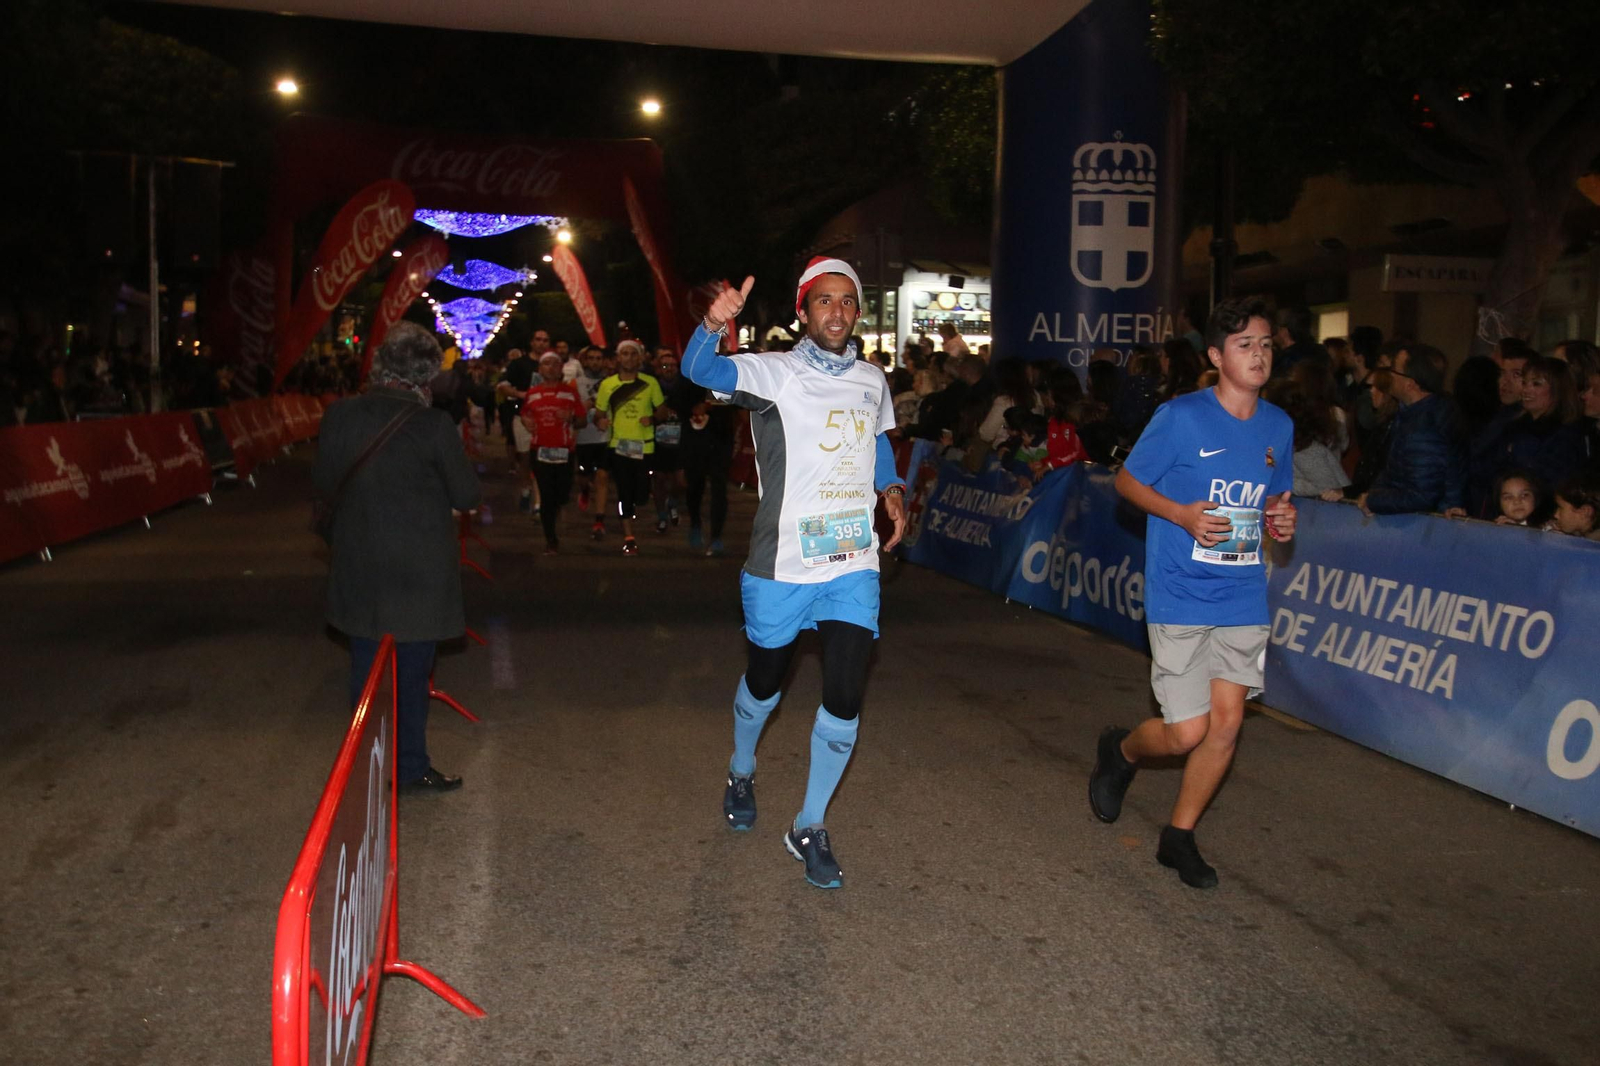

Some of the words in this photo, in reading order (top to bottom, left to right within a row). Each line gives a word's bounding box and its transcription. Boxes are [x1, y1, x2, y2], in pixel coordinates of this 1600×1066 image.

[1028, 306, 1175, 343] ALMERÍA
[819, 489, 865, 500] TRAINING
[1208, 478, 1266, 507] RCM
[834, 523, 863, 540] 395
[1284, 562, 1555, 660] AYUNTAMIENTO
[1269, 607, 1316, 653] DE
[1312, 620, 1458, 700] ALMERÍA
